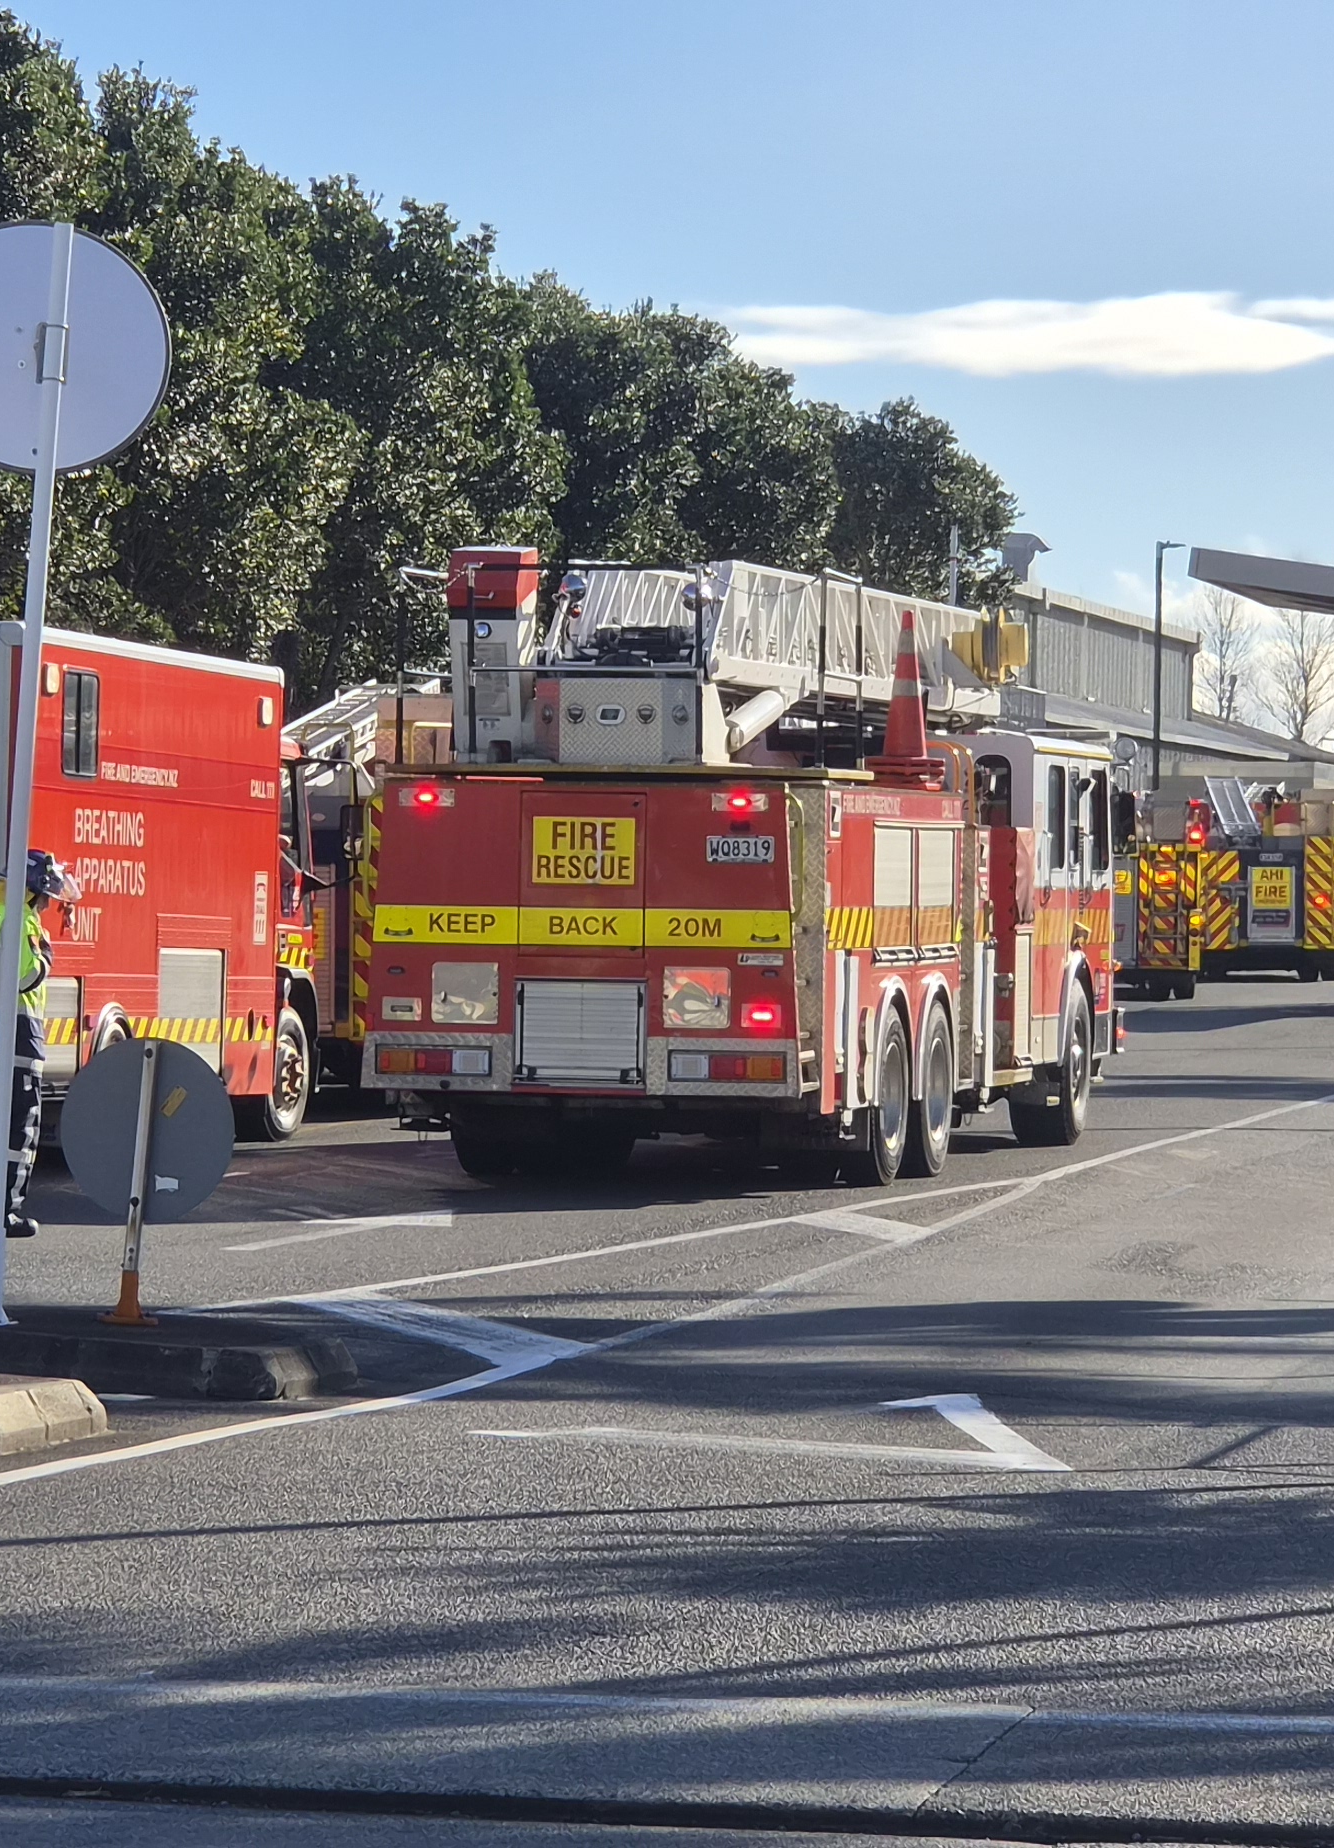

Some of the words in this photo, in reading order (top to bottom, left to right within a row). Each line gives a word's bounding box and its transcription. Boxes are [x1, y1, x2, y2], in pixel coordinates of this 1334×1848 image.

[250, 778, 266, 799] CALL
[74, 808, 145, 848] BREATHING
[551, 820, 617, 851] FIRE
[709, 840, 771, 857] WQ8319
[75, 857, 146, 897] APPARATUS
[536, 854, 631, 880] RESCUE
[1260, 869, 1284, 881] AHI
[1255, 886, 1288, 898] FIRE
[71, 905, 103, 942] UNIT
[428, 912, 497, 934] KEEP
[548, 915, 619, 936] BACK
[668, 917, 722, 938] 20M
